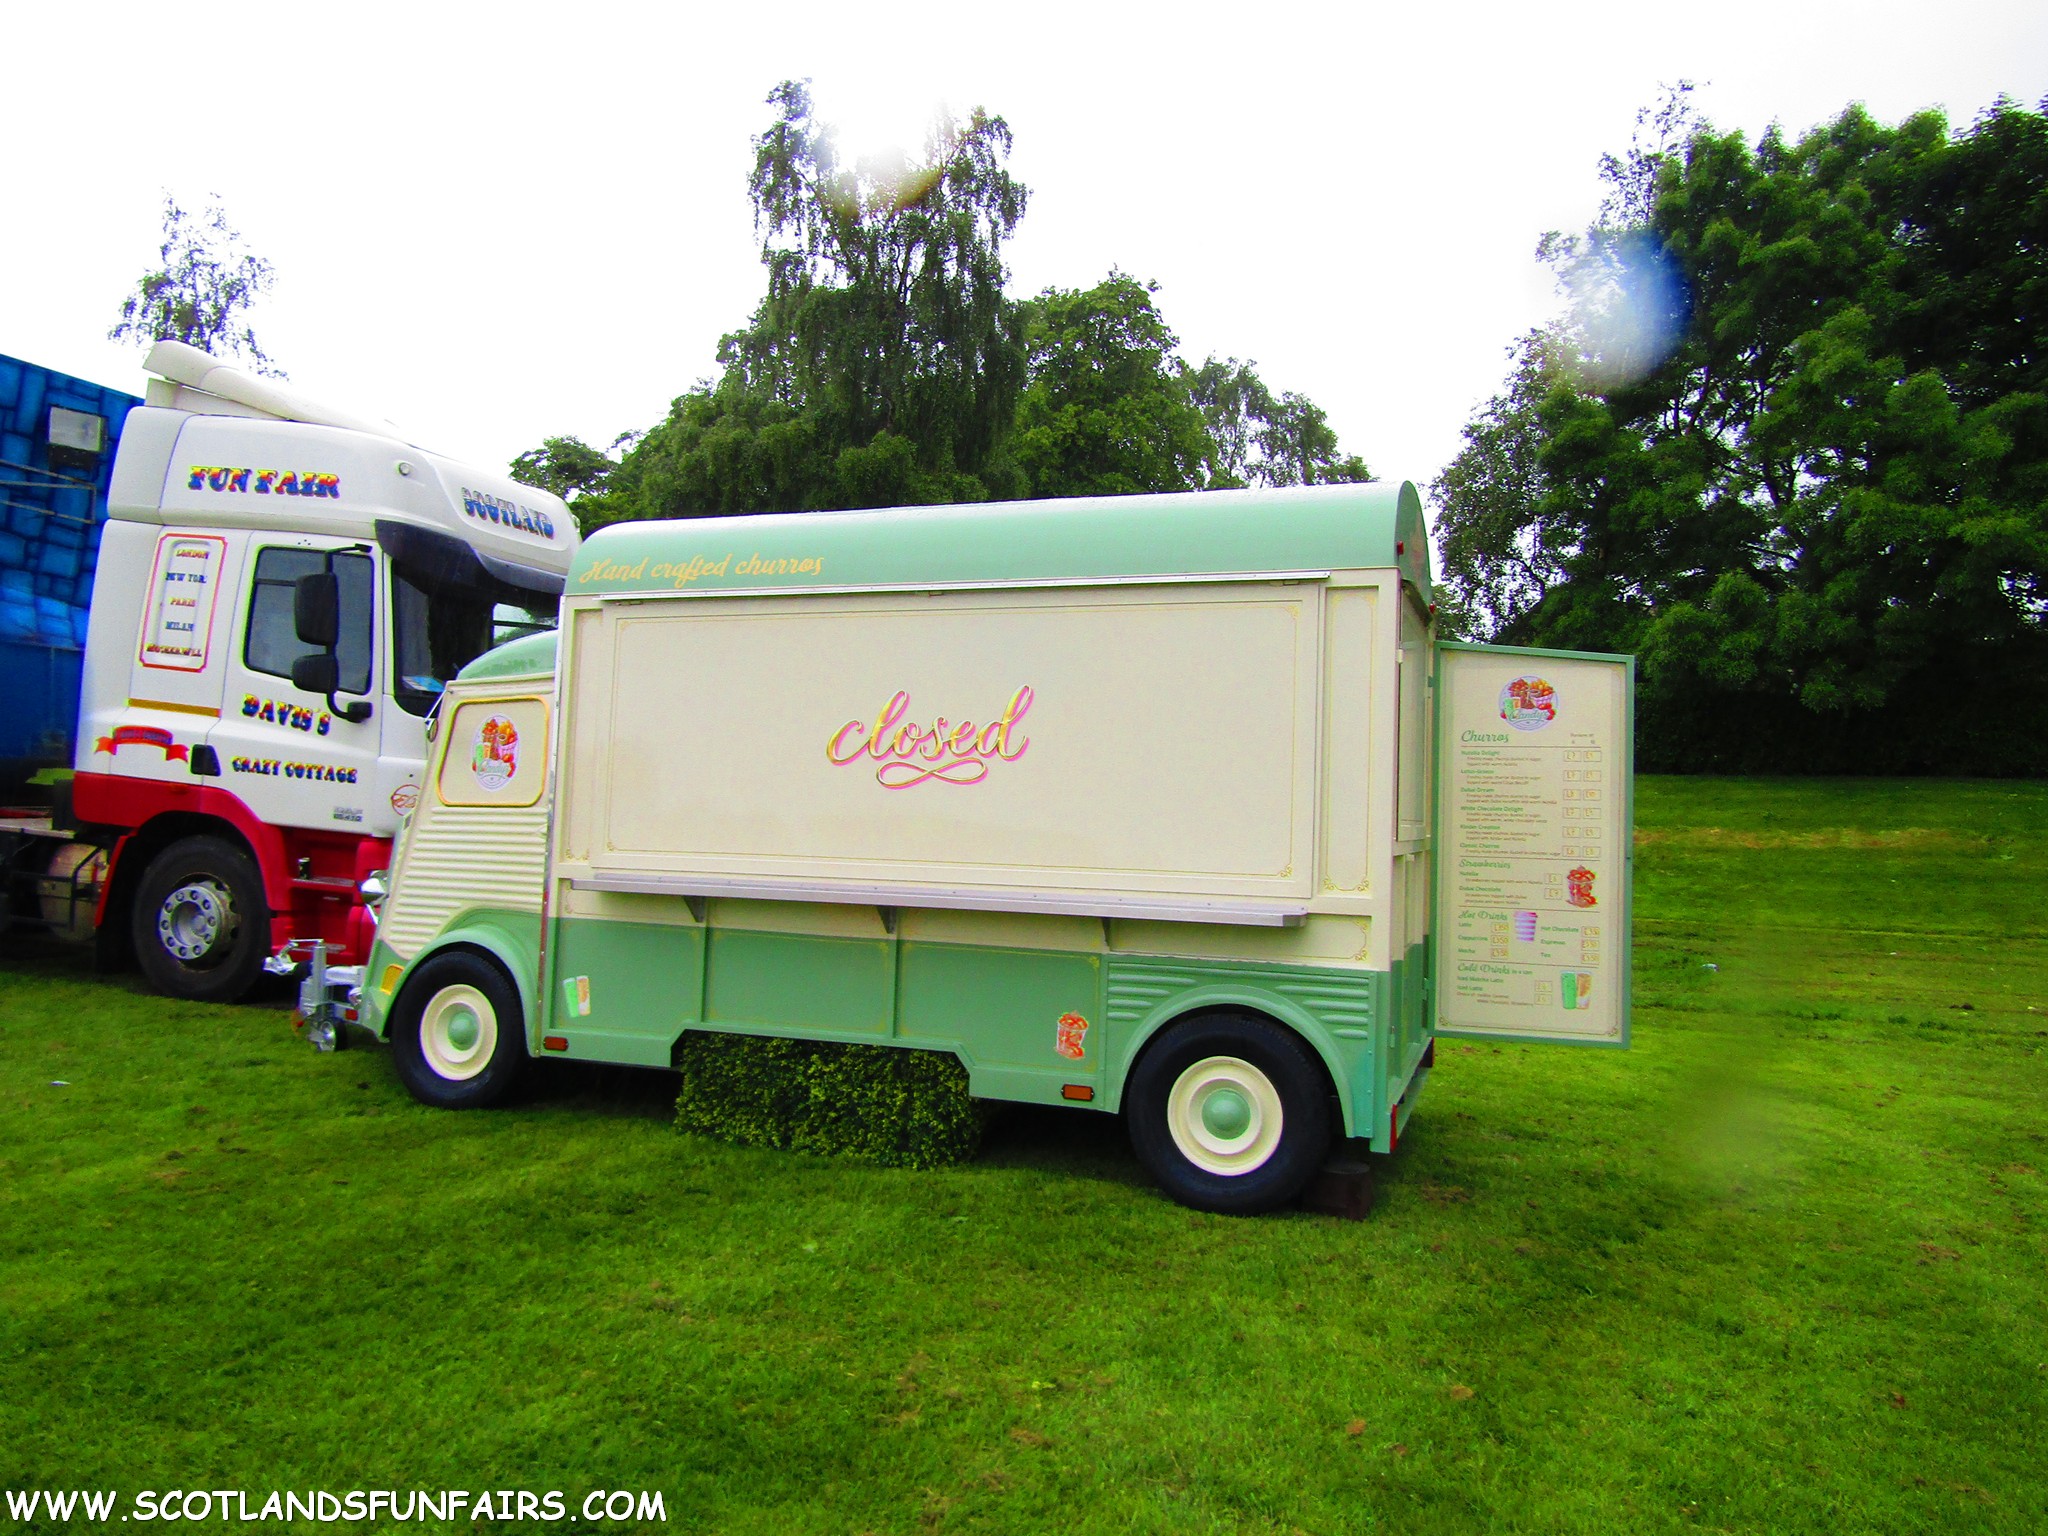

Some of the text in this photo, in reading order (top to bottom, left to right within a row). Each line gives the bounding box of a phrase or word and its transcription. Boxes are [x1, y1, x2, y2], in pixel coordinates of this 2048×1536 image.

[188, 465, 340, 499] FUN FAIR
[461, 486, 555, 540] SCOTLAND
[165, 571, 186, 581] NEW
[579, 551, 825, 589] Hand crafted churros
[170, 597, 196, 607] PARIS
[826, 684, 1034, 768] closed
[1461, 729, 1509, 743] Churros
[232, 756, 357, 784] CRAZY COTTAGE
